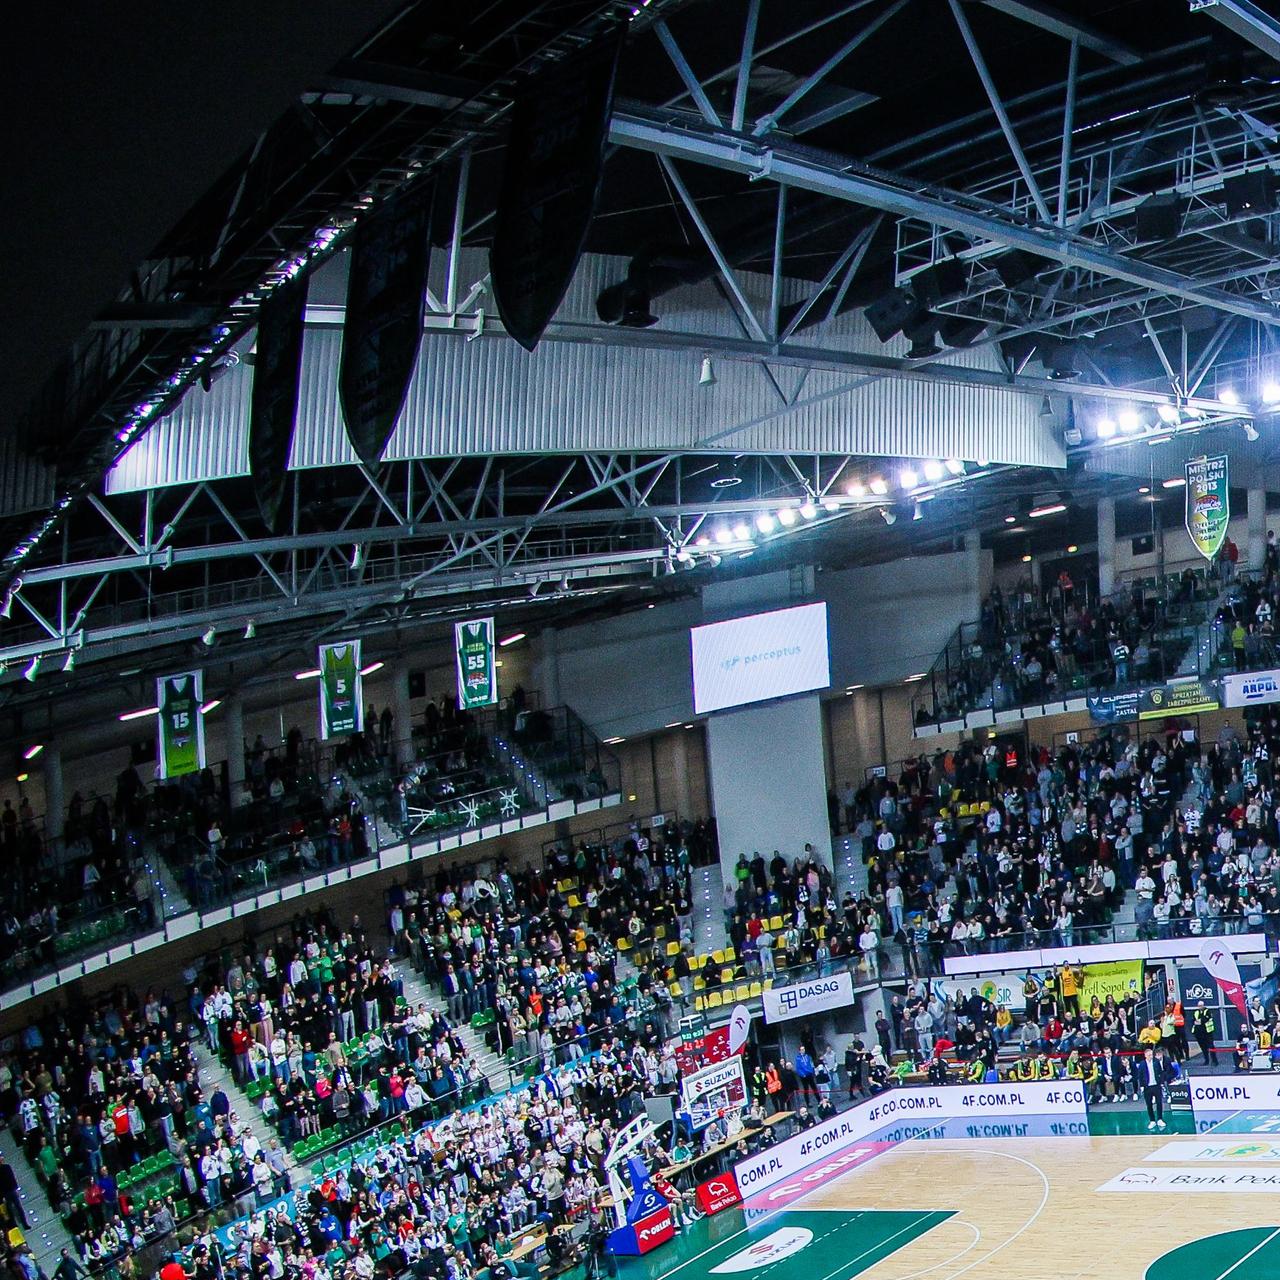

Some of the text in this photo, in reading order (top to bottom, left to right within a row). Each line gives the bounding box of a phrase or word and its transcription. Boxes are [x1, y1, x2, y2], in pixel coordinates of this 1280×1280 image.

[1189, 460, 1224, 475] MISTRZ
[1189, 471, 1224, 485] POLSKI
[1196, 482, 1217, 493] 2013
[468, 654, 485, 670] 55
[745, 646, 801, 665] perceptus
[336, 679, 346, 693] 5
[1243, 681, 1278, 695] ARPOL
[172, 712, 189, 729] 15
[800, 981, 839, 999] DASAG
[1100, 982, 1125, 995] Sopot
[704, 1068, 736, 1088] SUZUKI
[962, 1094, 1025, 1107] 4F.COM.PL
[1047, 1091, 1083, 1103] 4F.CO
[1192, 1087, 1250, 1100] .COM.PL
[800, 1122, 854, 1155] 4F.COM.PL
[802, 1148, 872, 1182] ORLEN
[739, 1158, 783, 1189] .COM.PL
[1169, 1174, 1228, 1185] Bank
[650, 1218, 671, 1235] ORLEN
[754, 1235, 804, 1264] SUZUKI
